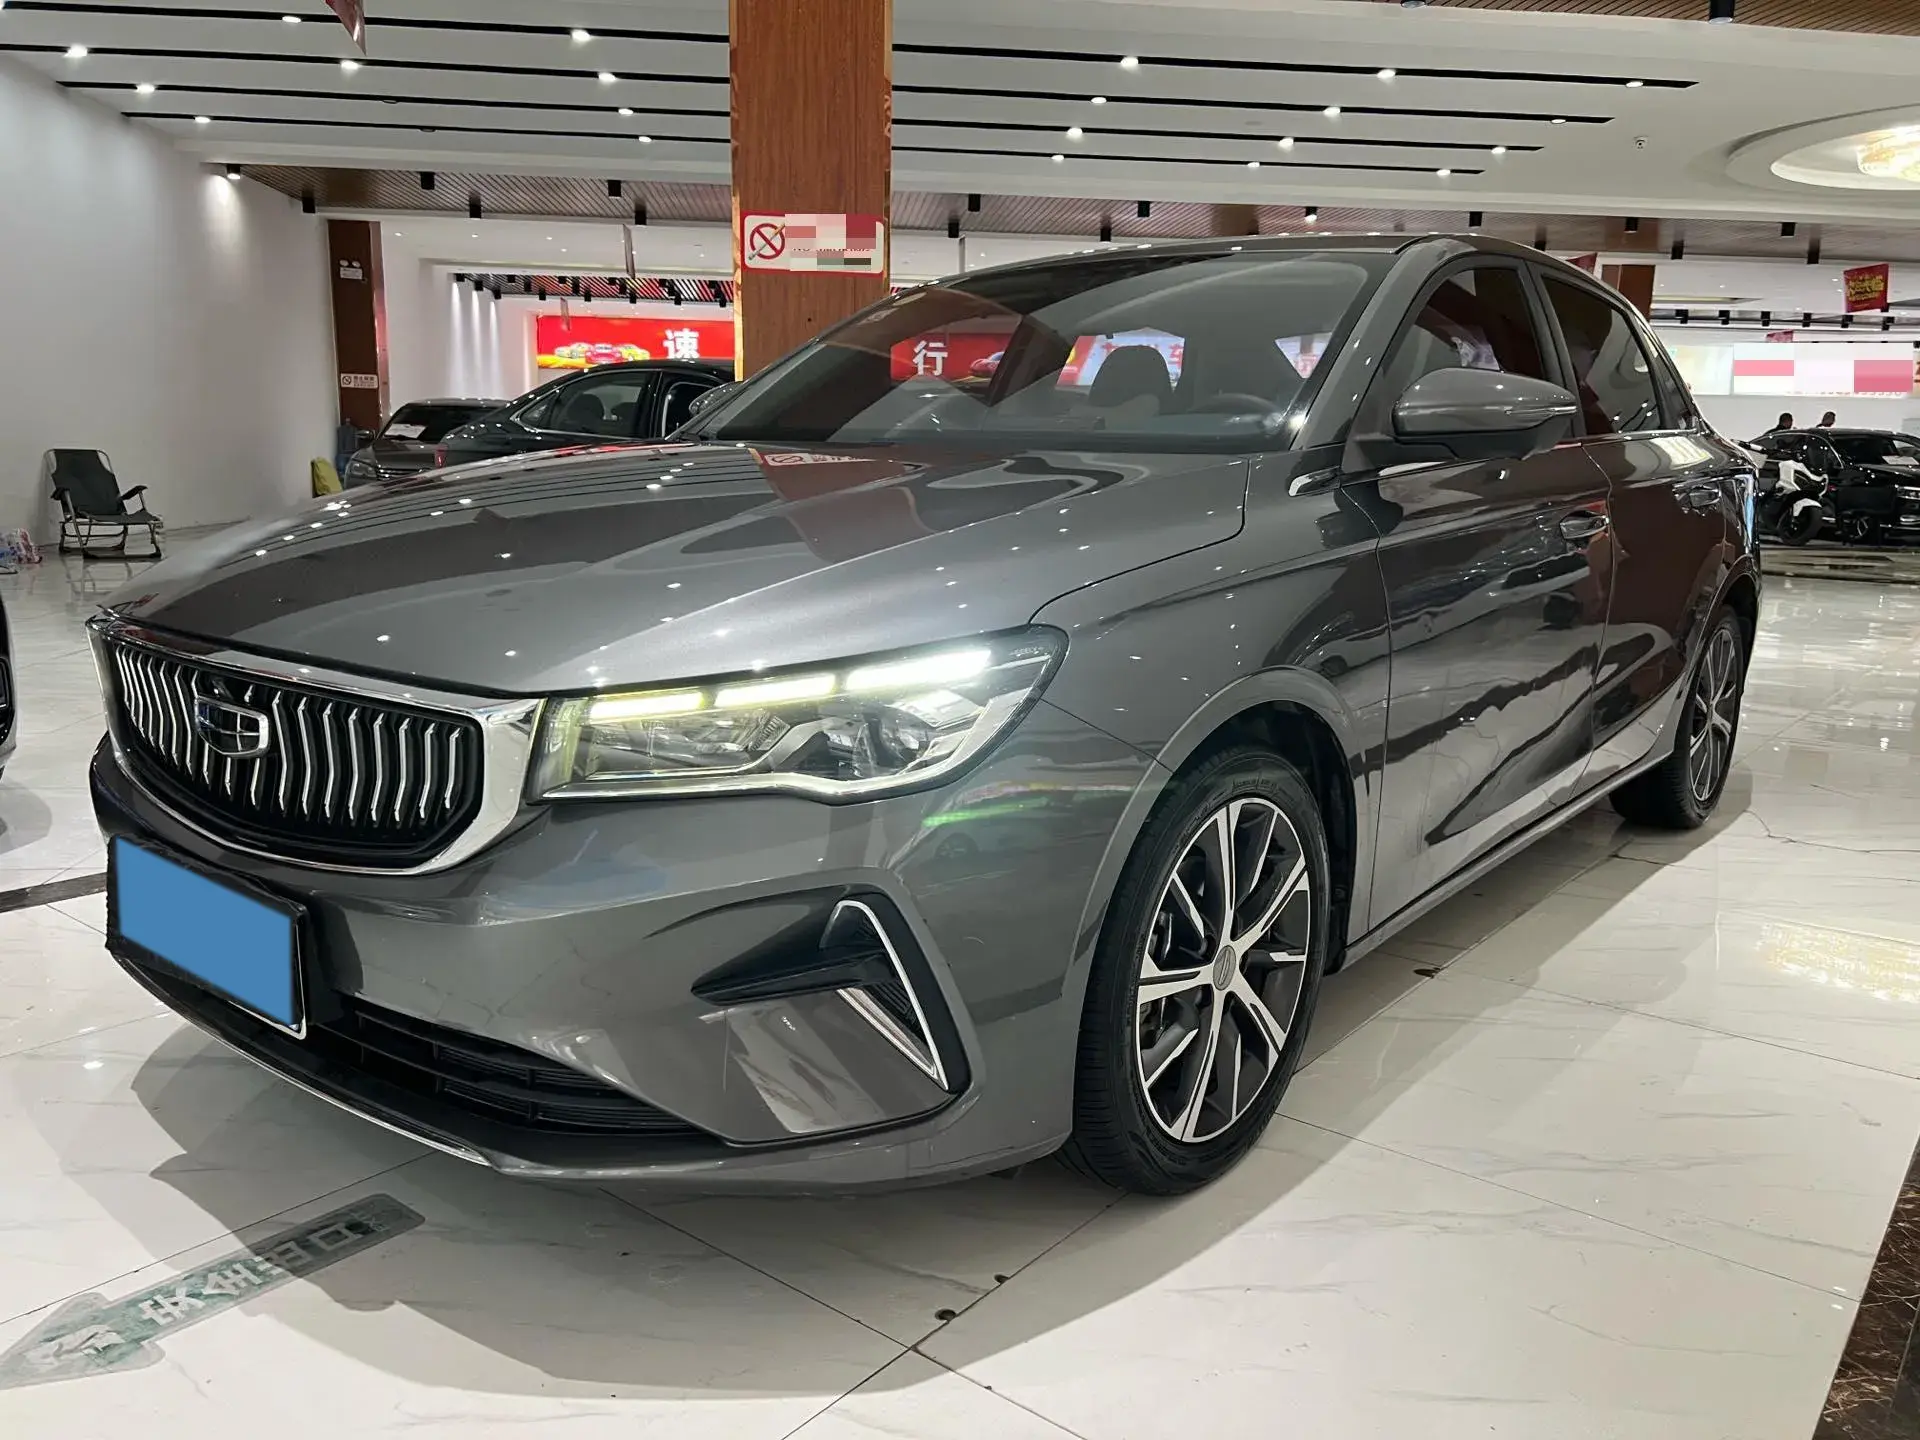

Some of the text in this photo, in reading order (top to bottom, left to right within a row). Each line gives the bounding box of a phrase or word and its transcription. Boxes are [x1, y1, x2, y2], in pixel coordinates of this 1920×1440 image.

[663, 328, 949, 376] 速 行
[139, 1222, 361, 1326] 安全出口
